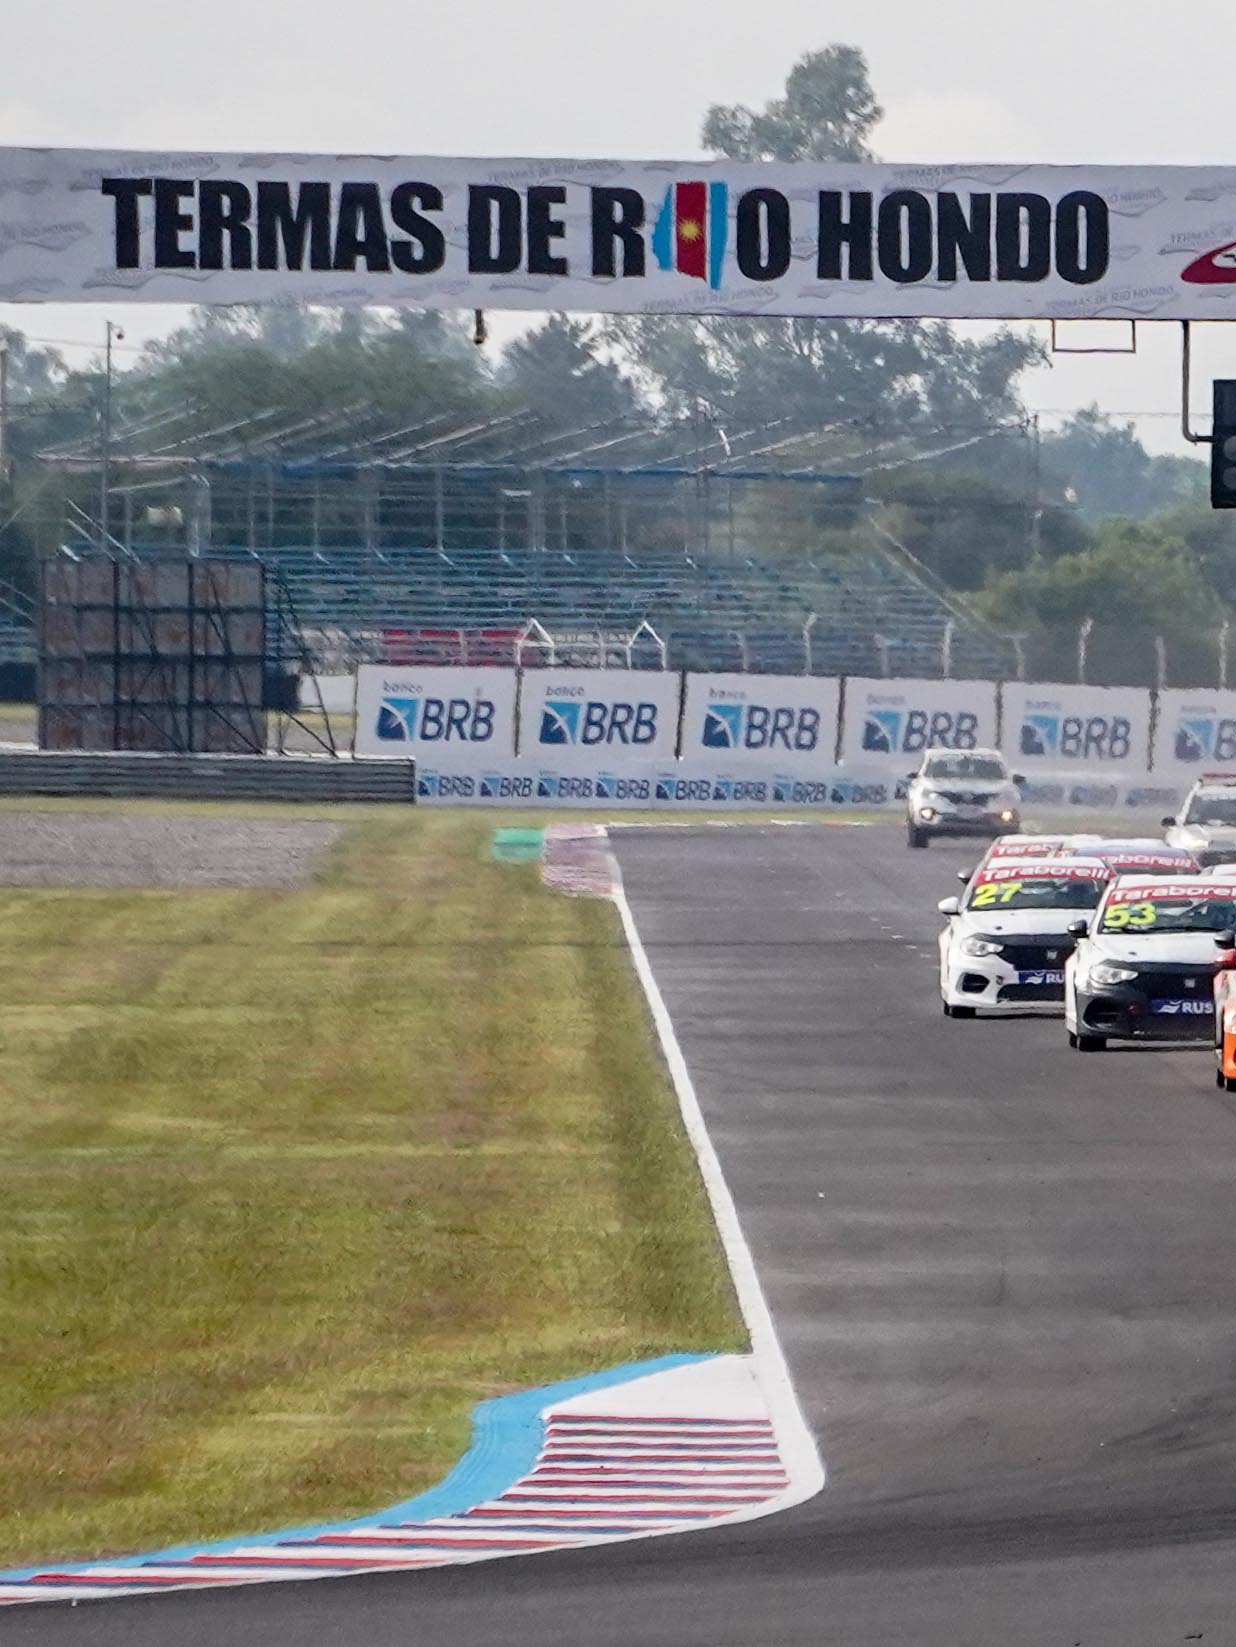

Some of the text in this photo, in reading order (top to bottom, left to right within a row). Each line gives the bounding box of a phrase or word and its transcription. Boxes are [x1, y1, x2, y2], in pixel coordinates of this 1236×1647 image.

[102, 177, 446, 274] TERMAS
[468, 183, 568, 276] DE
[817, 189, 1110, 285] HONDO
[383, 680, 424, 694] banco
[546, 685, 585, 697] banco
[420, 698, 497, 742] BRB
[581, 702, 658, 746] BRB
[744, 706, 821, 751] BRB
[902, 710, 979, 753] BRB
[1060, 716, 1132, 759] BRB
[438, 776, 475, 798] BRB
[499, 776, 534, 798] BRB
[558, 777, 594, 798] BRB
[615, 779, 650, 799] BRB
[674, 780, 711, 801] BRB
[733, 781, 768, 802] BRB
[791, 782, 827, 803] BRB
[983, 865, 1111, 882] Taraborelli
[972, 882, 1022, 908] 27
[1103, 903, 1157, 928] 53
[1045, 970, 1065, 984] RU
[1181, 1000, 1214, 1015] RUS
